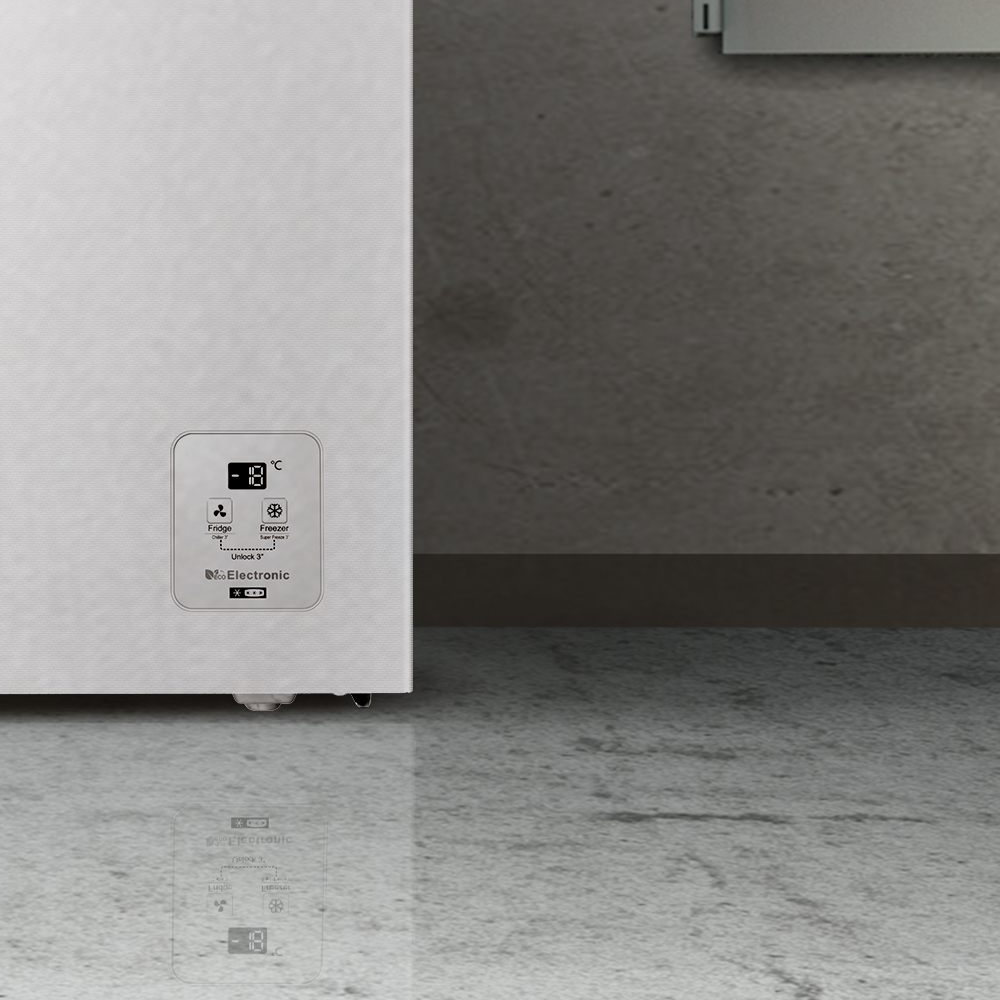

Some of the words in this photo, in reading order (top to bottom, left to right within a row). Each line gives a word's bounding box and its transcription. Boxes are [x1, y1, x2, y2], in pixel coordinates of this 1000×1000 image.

[270, 460, 282, 471] °C
[208, 524, 232, 533] Fridge
[260, 524, 289, 532] Freezer
[227, 570, 290, 580] Electronic
